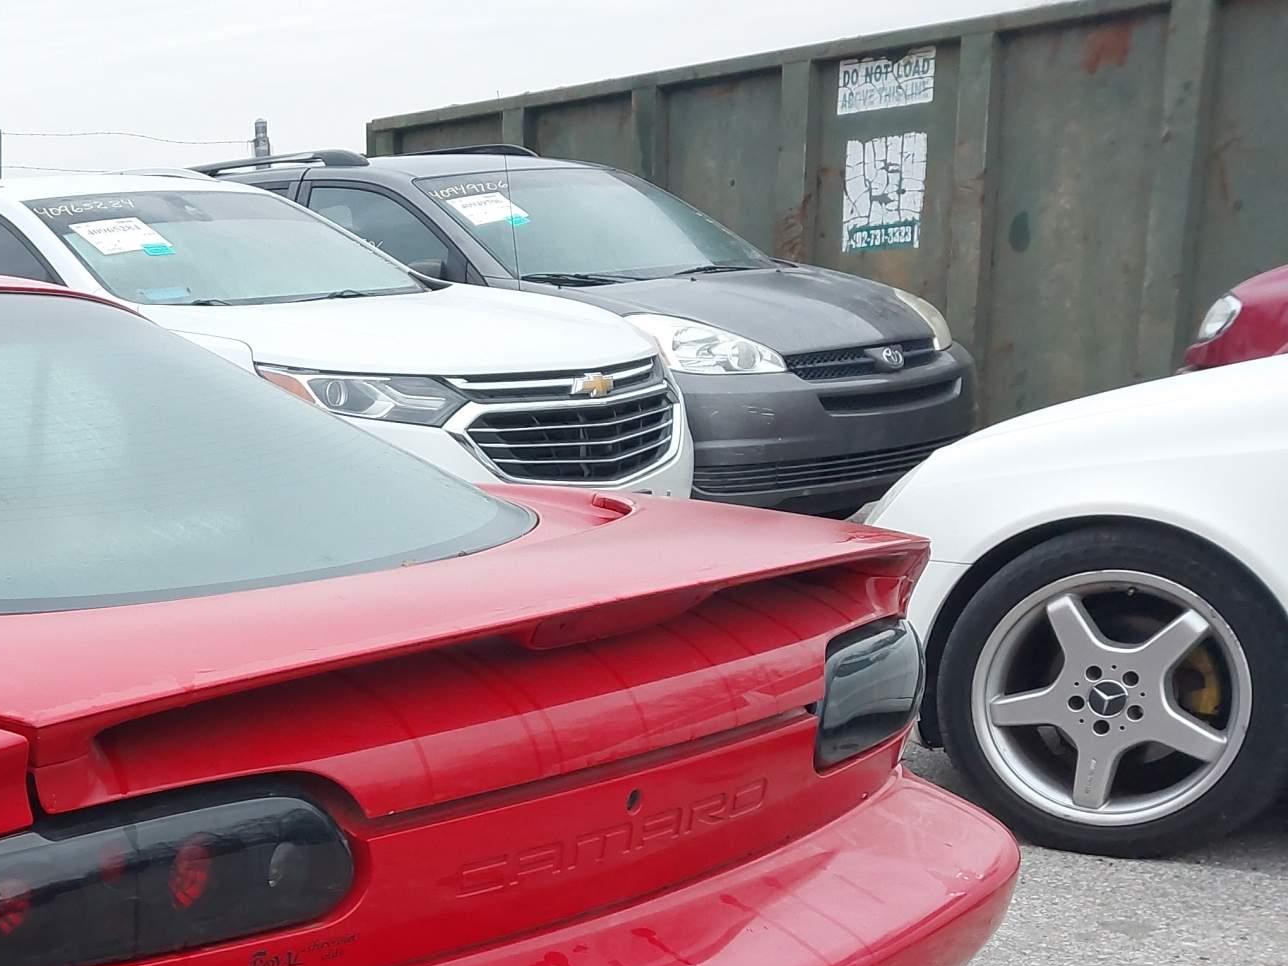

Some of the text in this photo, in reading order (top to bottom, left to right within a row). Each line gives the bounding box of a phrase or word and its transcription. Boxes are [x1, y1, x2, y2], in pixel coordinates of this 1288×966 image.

[842, 56, 930, 87] DO NOT LOAD
[456, 777, 768, 898] CAMARO
